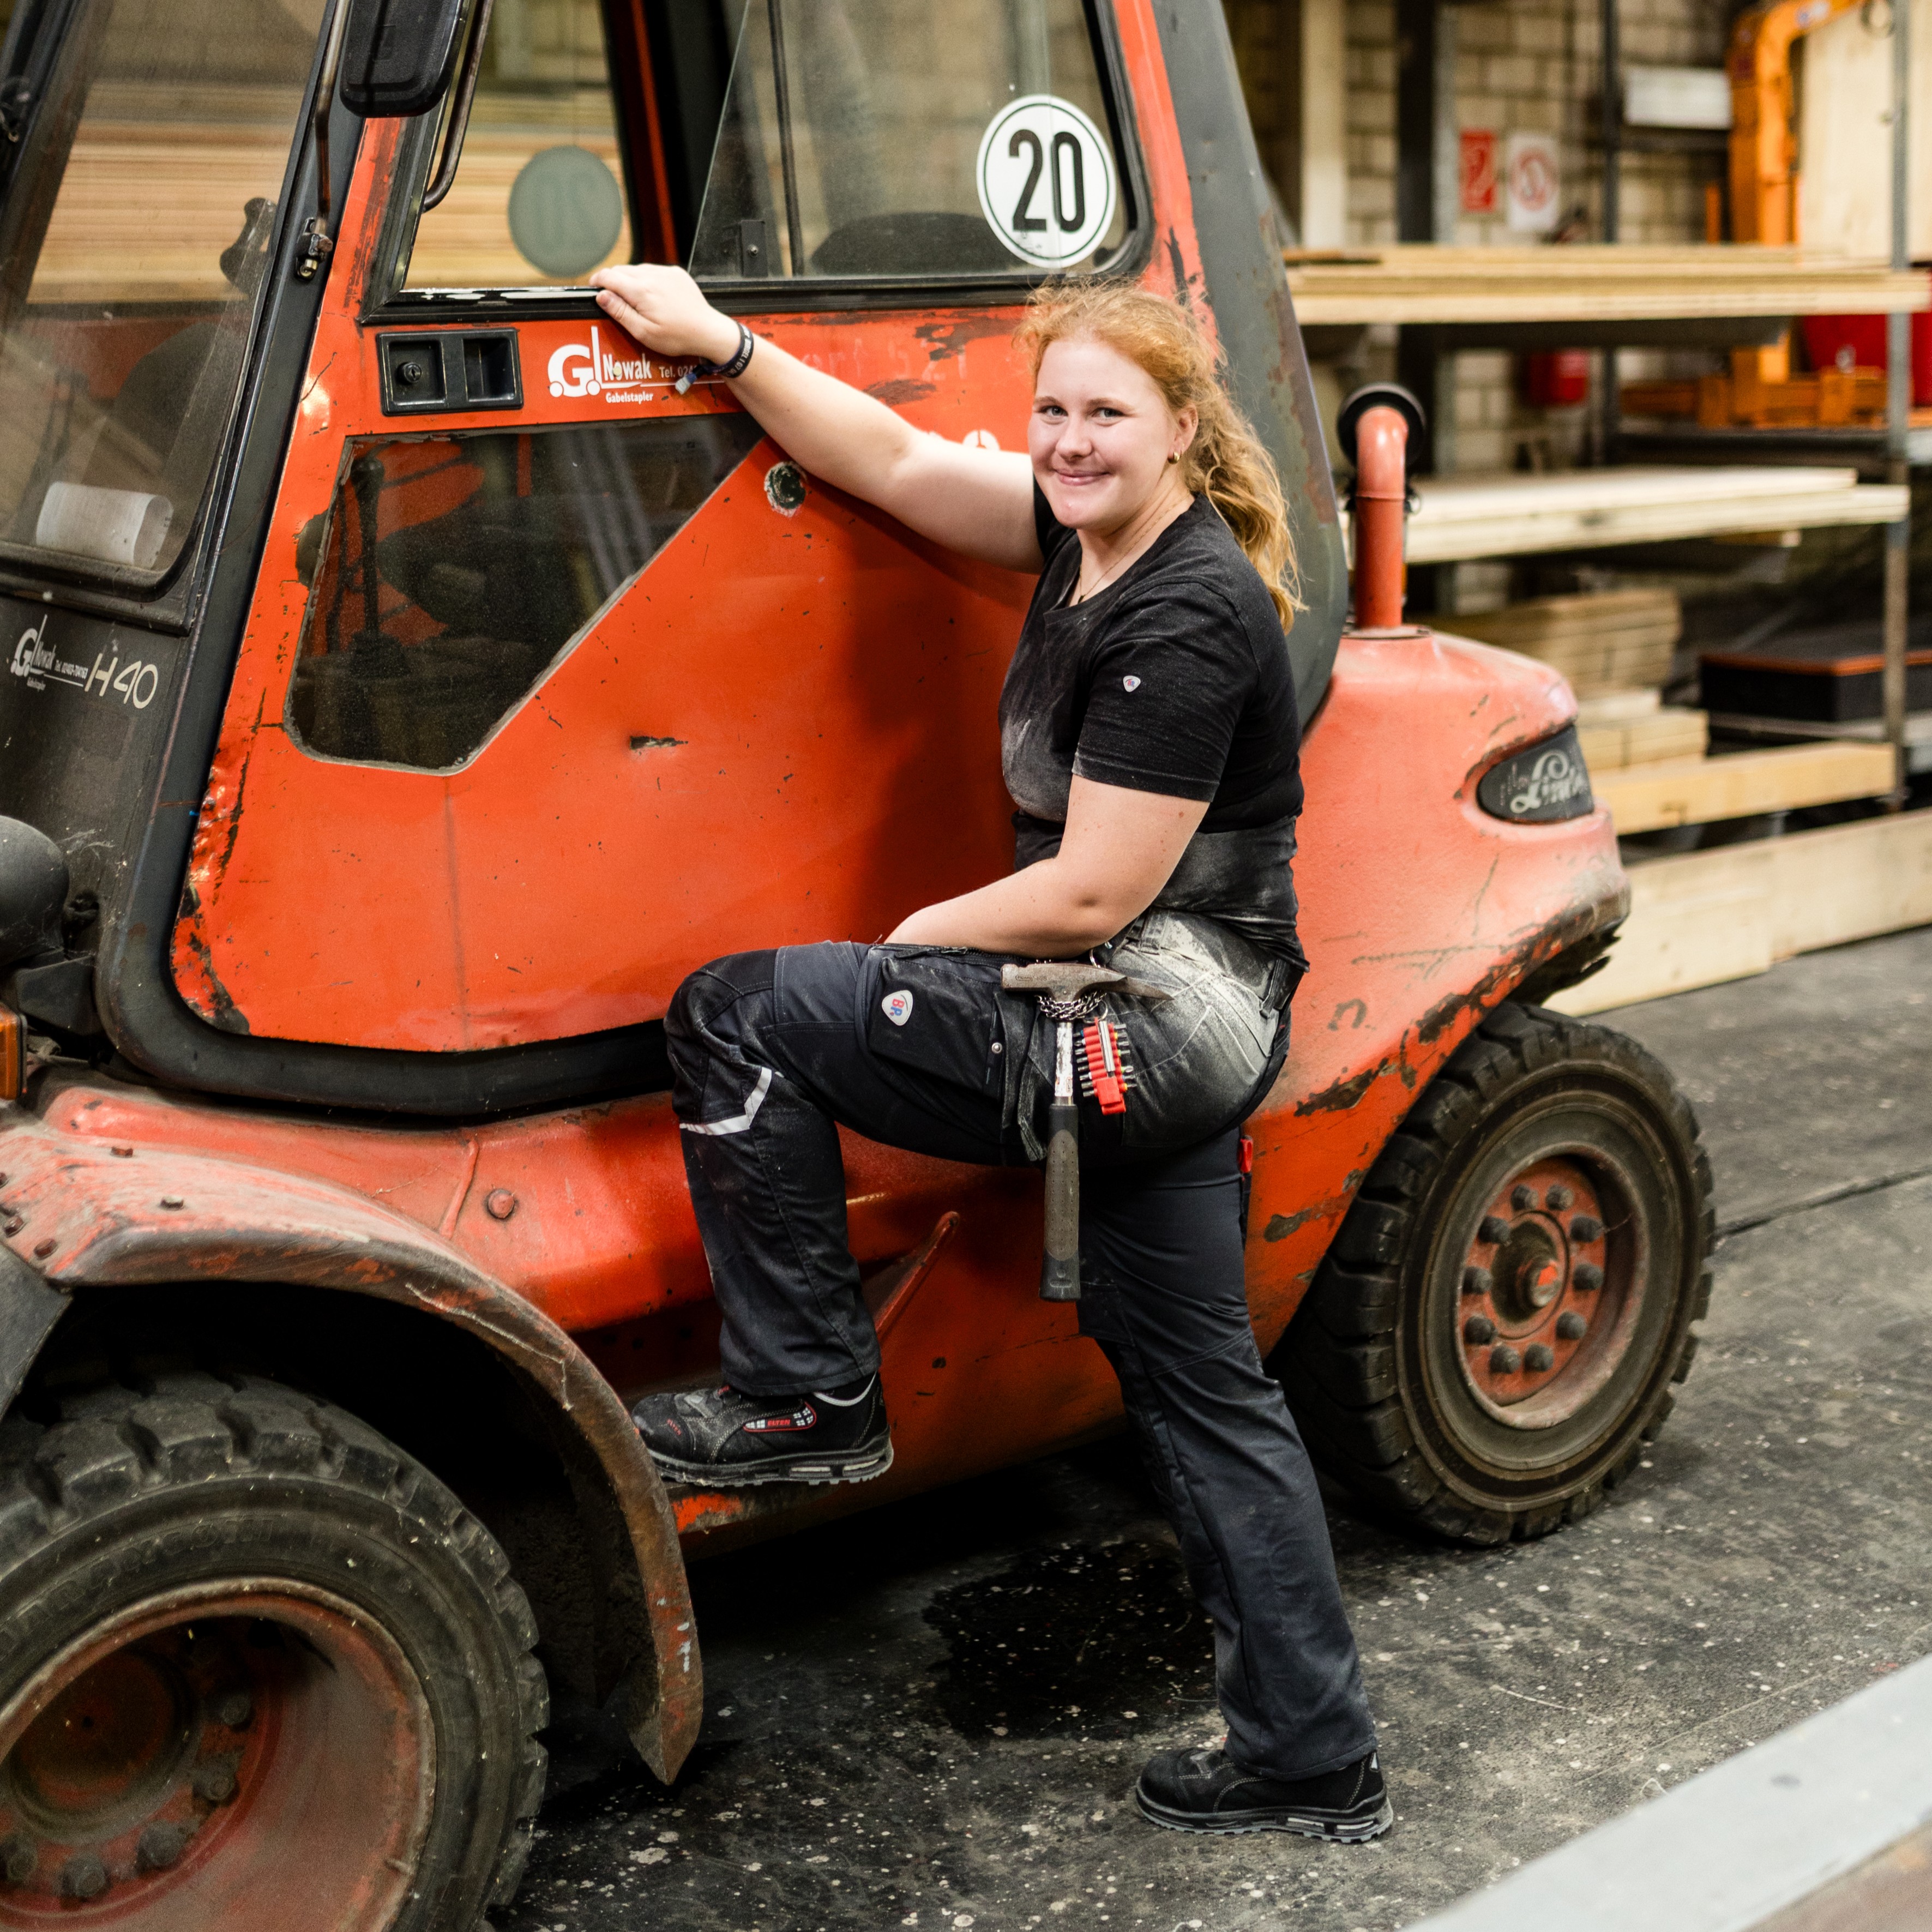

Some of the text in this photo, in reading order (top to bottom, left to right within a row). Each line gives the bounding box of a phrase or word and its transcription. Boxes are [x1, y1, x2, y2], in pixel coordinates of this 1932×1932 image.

[1009, 129, 1085, 233] 20
[603, 353, 652, 381] Nowak
[659, 365, 676, 378] Tel.
[605, 392, 653, 405] Gabelstapler
